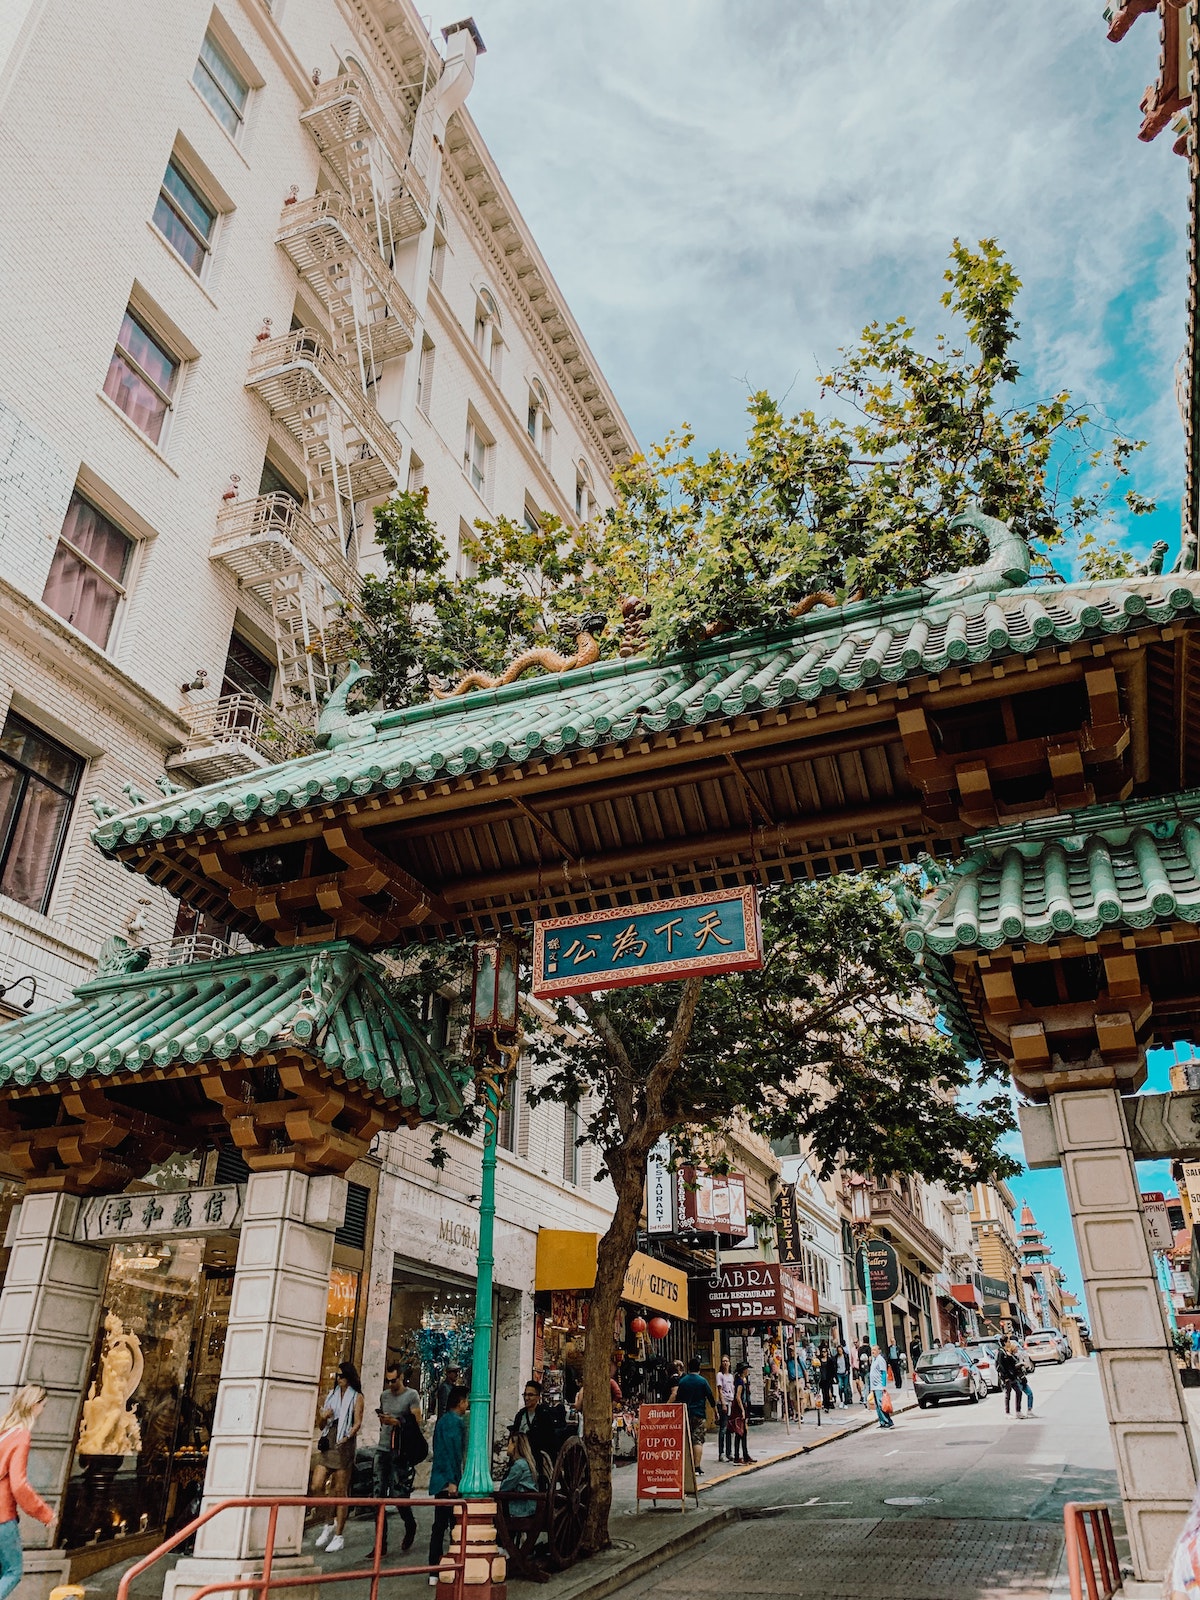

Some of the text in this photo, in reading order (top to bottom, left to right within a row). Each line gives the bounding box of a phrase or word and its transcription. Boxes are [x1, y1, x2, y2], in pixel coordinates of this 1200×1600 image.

[1143, 1204, 1165, 1213] PPING
[780, 1186, 796, 1260] VENEZIA
[440, 1217, 479, 1251] MICHA
[867, 1249, 888, 1257] enezia
[708, 1269, 775, 1288] SABRA
[650, 1274, 679, 1303] GIFTS
[709, 1292, 730, 1300] GRILL
[731, 1289, 776, 1299] RESTAURANT
[648, 1409, 676, 1419] Michael
[646, 1437, 676, 1447] UP TO
[641, 1450, 682, 1460] 70% OFF
[655, 1468, 679, 1476] Shipping
